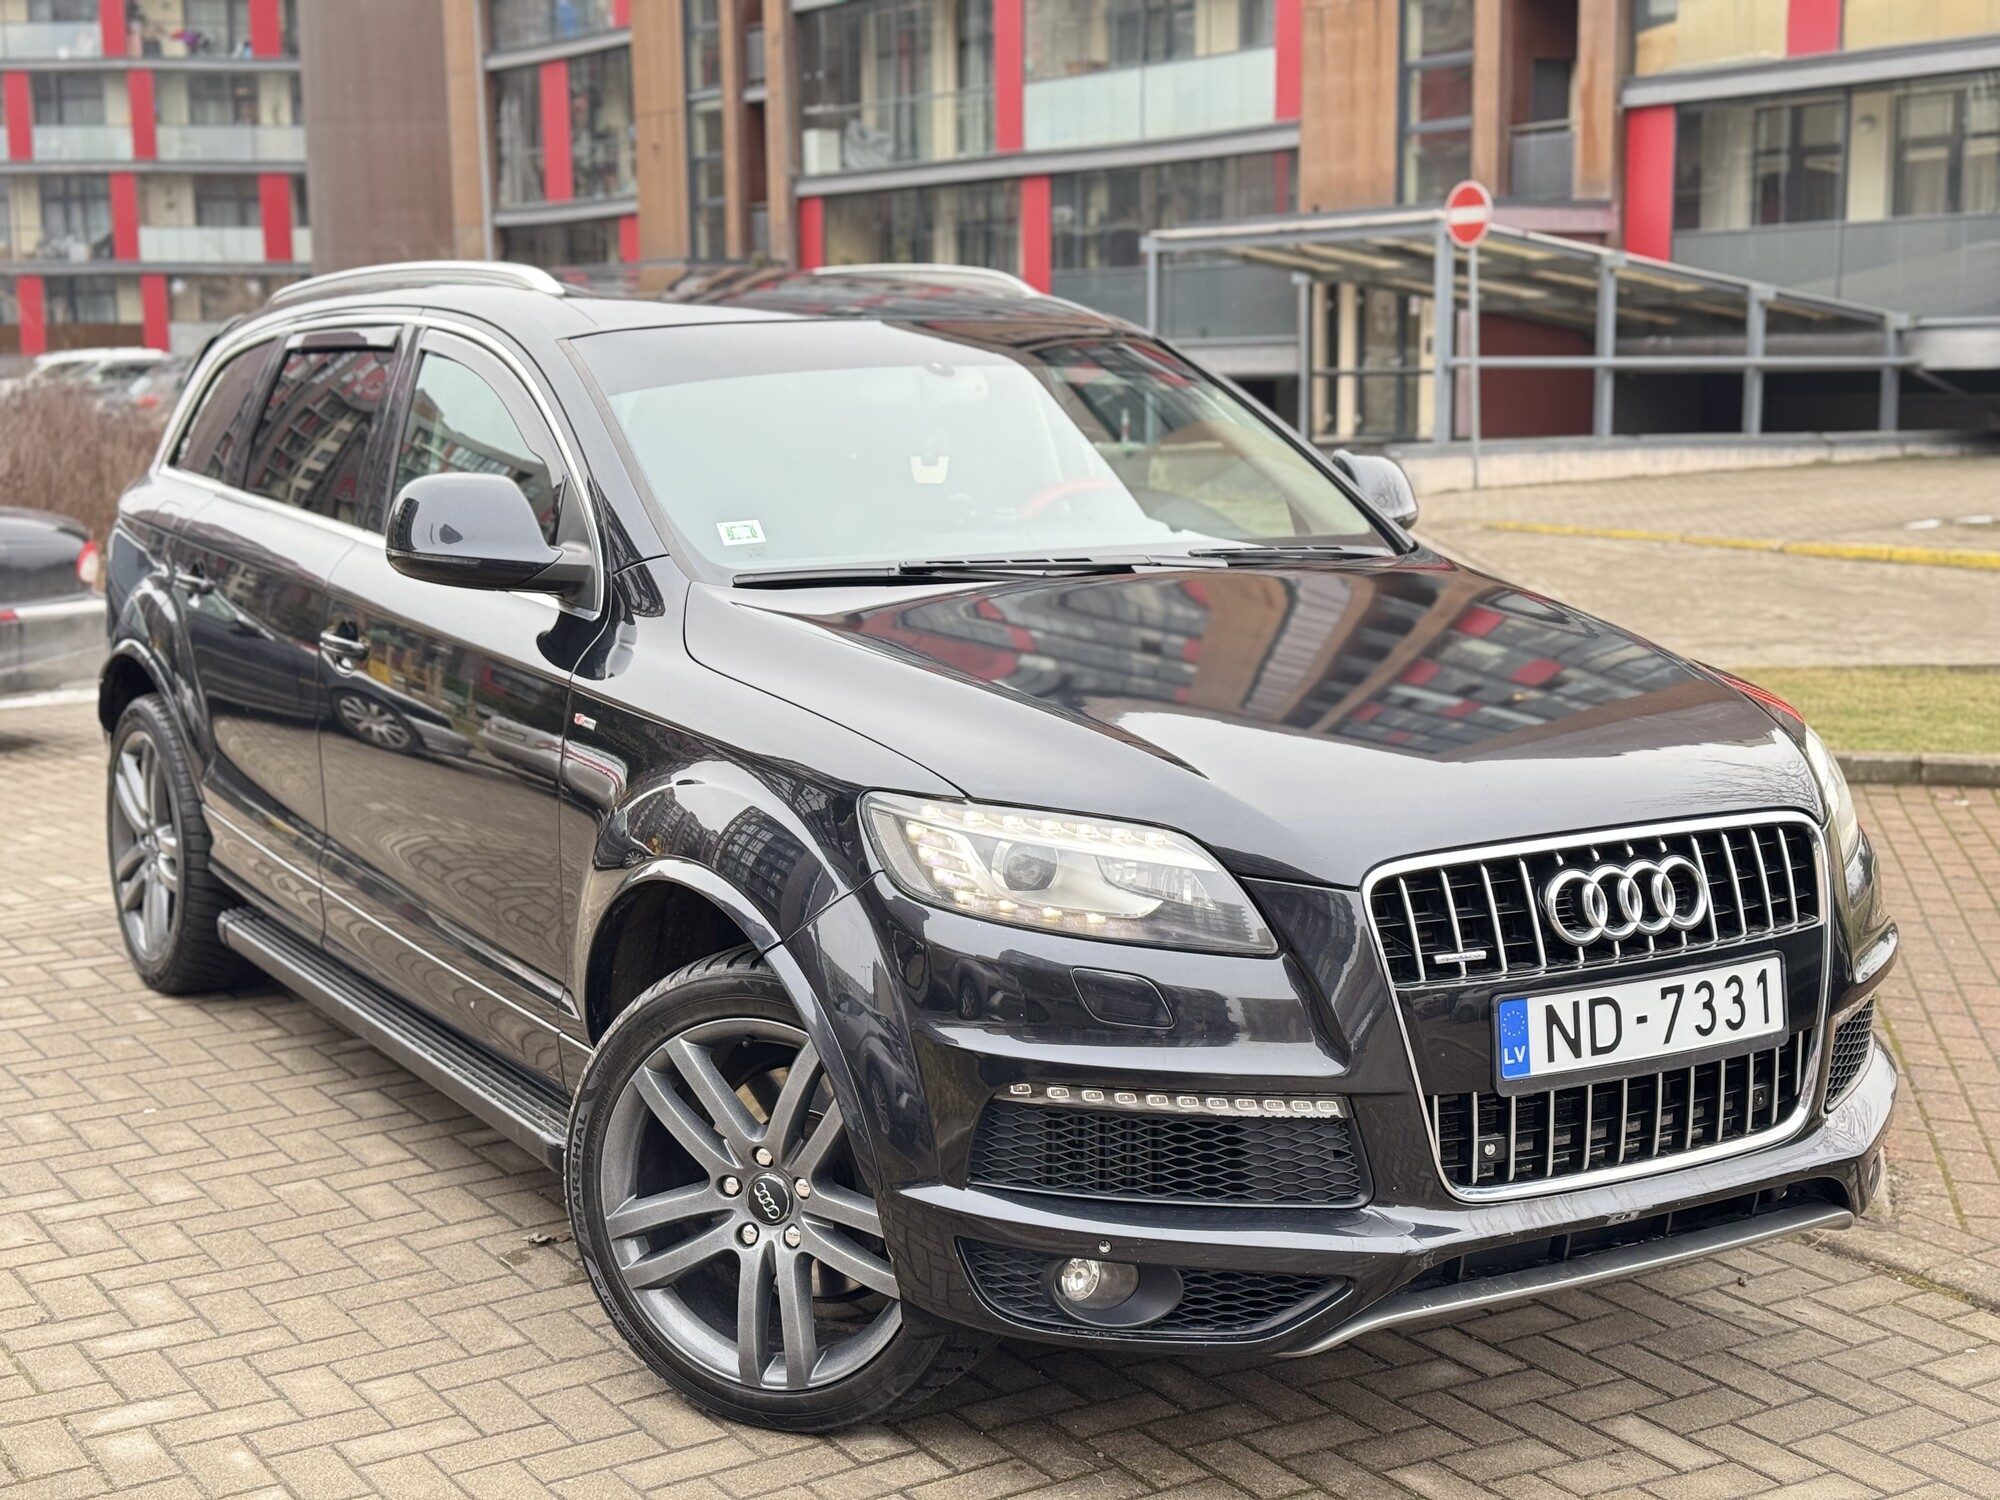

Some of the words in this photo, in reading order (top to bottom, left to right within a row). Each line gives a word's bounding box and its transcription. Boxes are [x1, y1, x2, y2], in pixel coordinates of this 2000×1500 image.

[1504, 1045, 1526, 1065] LV
[1545, 968, 1770, 1063] ND-7331
[571, 1113, 588, 1234] MARSHAL
